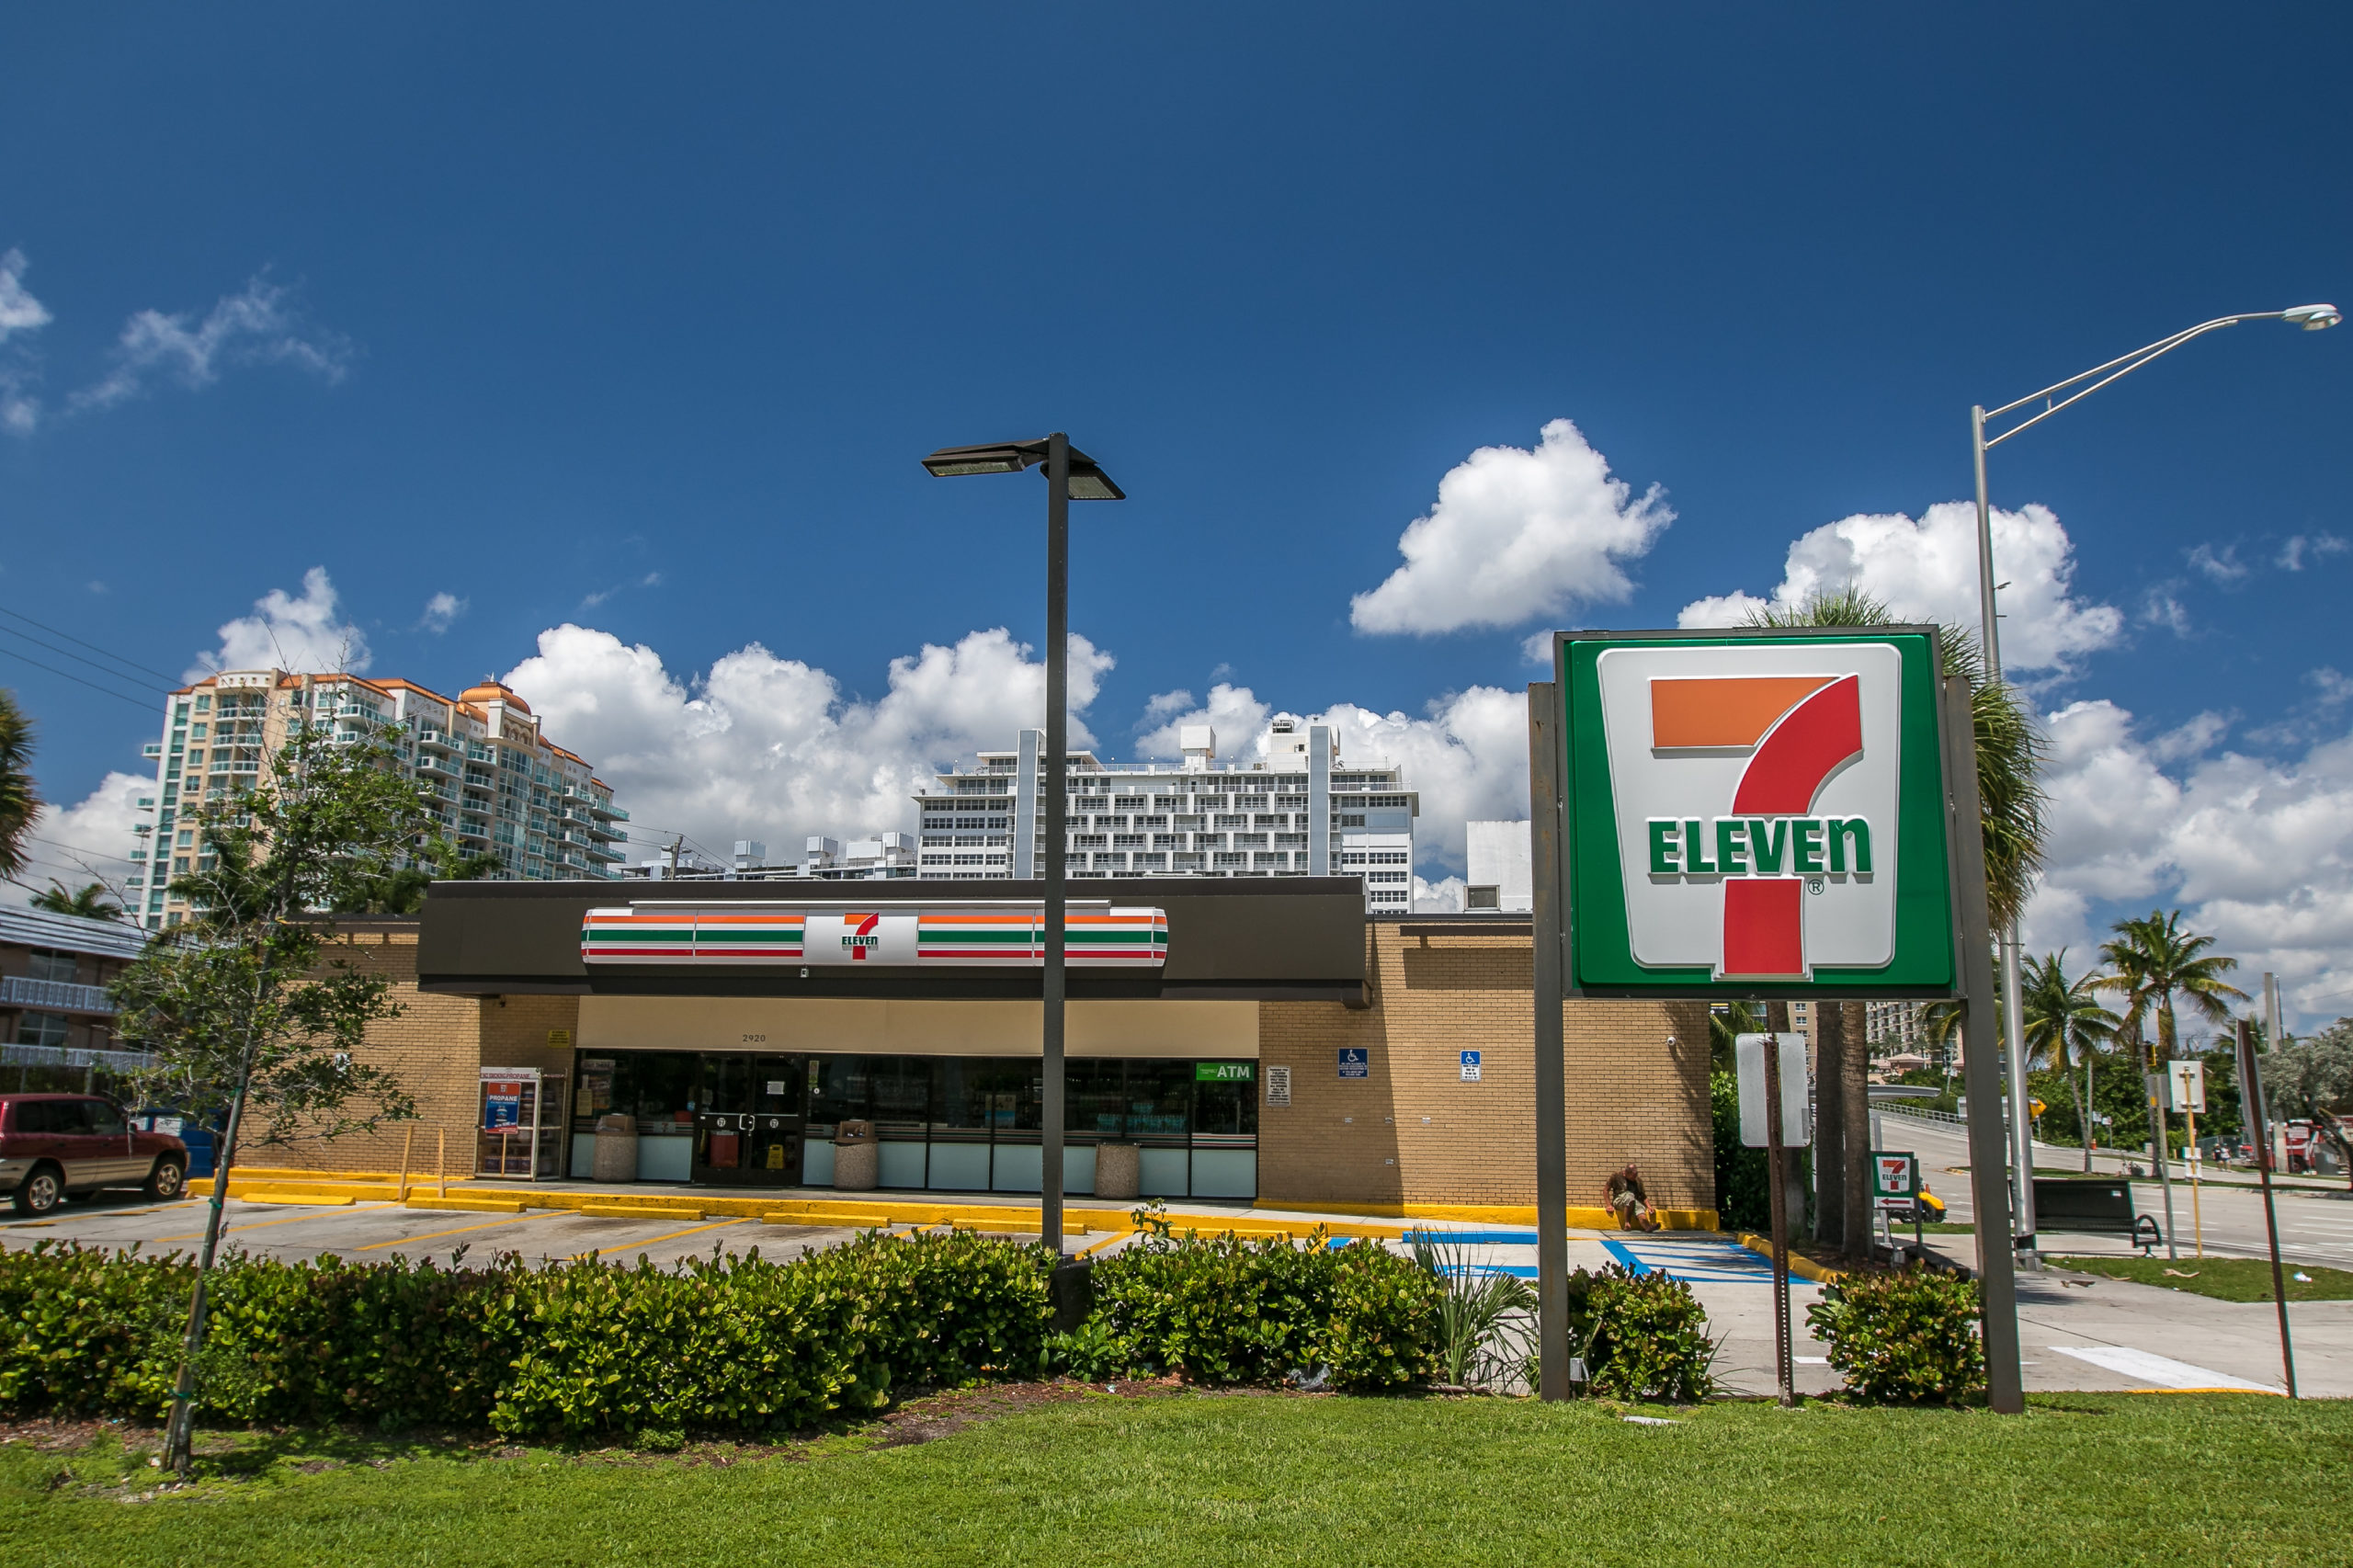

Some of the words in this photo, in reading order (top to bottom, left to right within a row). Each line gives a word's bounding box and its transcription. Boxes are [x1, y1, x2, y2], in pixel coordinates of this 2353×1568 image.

[1649, 674, 1864, 975] 7
[844, 913, 879, 960] 7
[743, 1034, 766, 1042] 2920
[1217, 1065, 1250, 1078] ATM
[1882, 1160, 1905, 1190] 7
